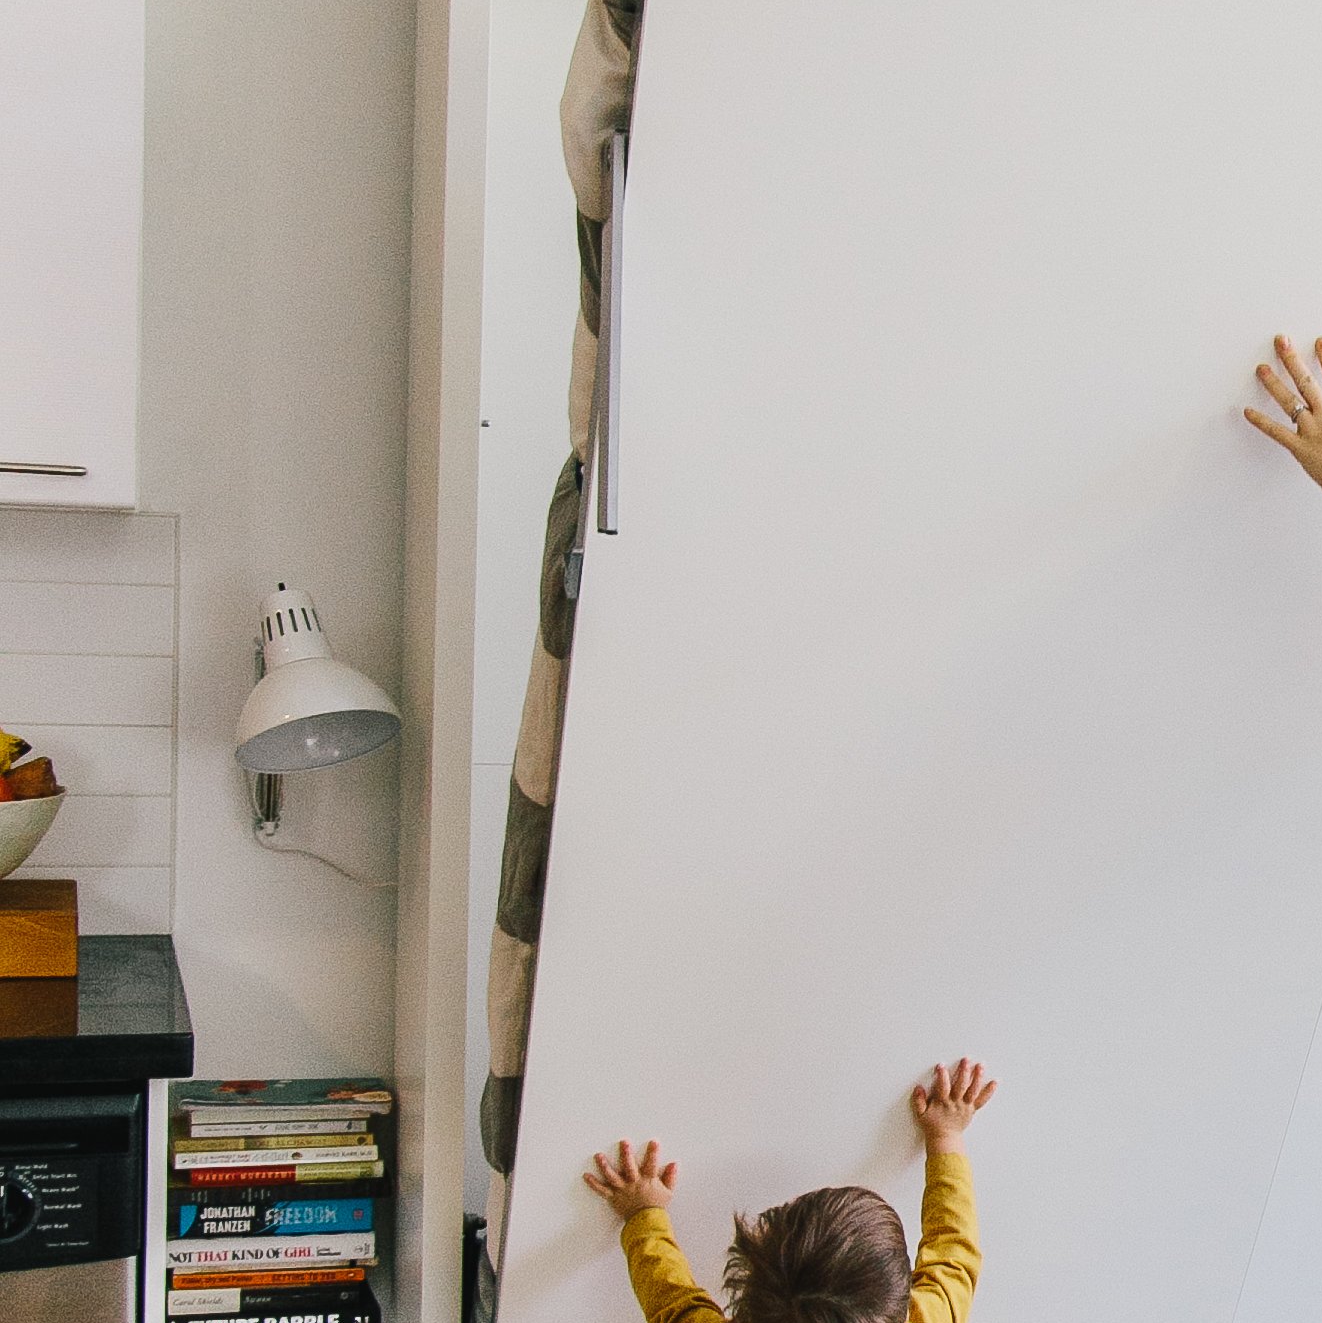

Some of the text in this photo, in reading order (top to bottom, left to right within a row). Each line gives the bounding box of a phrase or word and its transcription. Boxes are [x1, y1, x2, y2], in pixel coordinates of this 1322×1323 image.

[200, 1205, 256, 1220] JONATHAN
[264, 1204, 338, 1226] FREEDOM
[203, 1219, 251, 1234] FRANZEN
[169, 1251, 194, 1264] NOT
[196, 1250, 229, 1262] THAT
[231, 1247, 264, 1261] KIND
[266, 1246, 284, 1259] OF
[284, 1246, 312, 1259] GIRL
